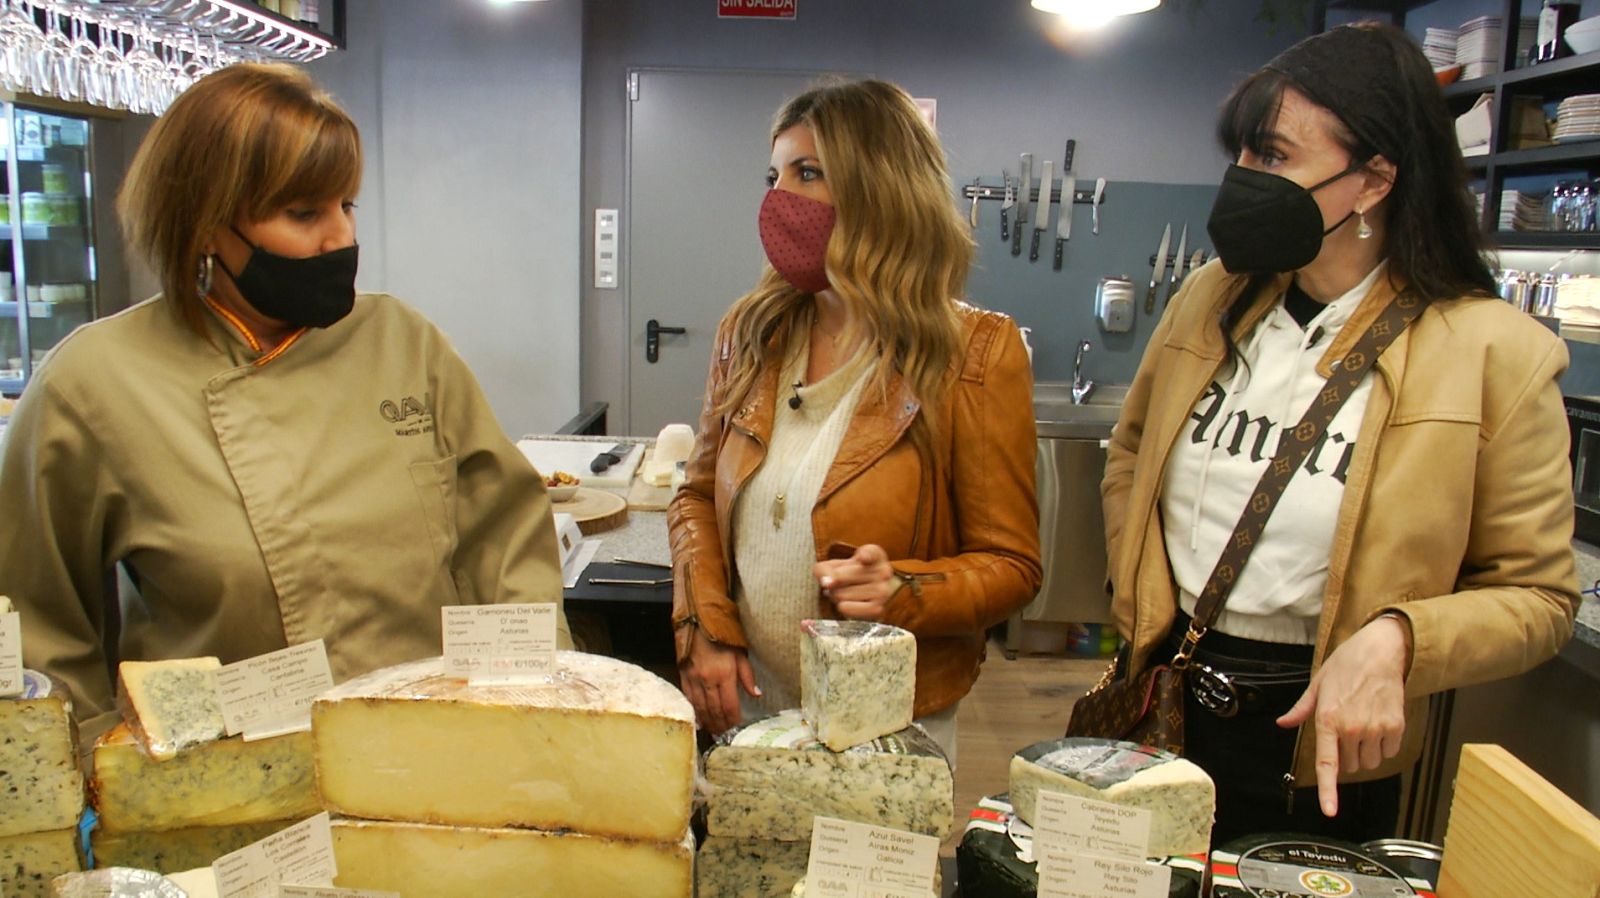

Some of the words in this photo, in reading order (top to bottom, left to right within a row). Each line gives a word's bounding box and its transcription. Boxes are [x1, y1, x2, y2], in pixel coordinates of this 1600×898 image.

[746, 0, 793, 8] SALIDA
[1191, 381, 1357, 485] Amri
[477, 608, 515, 617] Gamoneu
[517, 607, 531, 615] Del
[533, 607, 551, 615] Valle
[1081, 802, 1115, 815] Cabrales
[1118, 808, 1137, 818] DOP
[1091, 824, 1120, 835] Asturias
[869, 830, 888, 840] Azul
[890, 833, 914, 844] Savel
[868, 841, 889, 851] Airas
[876, 854, 904, 865] Galicia
[1288, 849, 1300, 857] el
[1300, 850, 1347, 863] Teyedu
[1094, 860, 1111, 872] Rey
[1115, 863, 1131, 873] Silo
[1133, 866, 1154, 878] Rojo
[1104, 872, 1120, 883] Rey
[1122, 875, 1138, 884] Silo
[1103, 883, 1136, 895] Asturias
